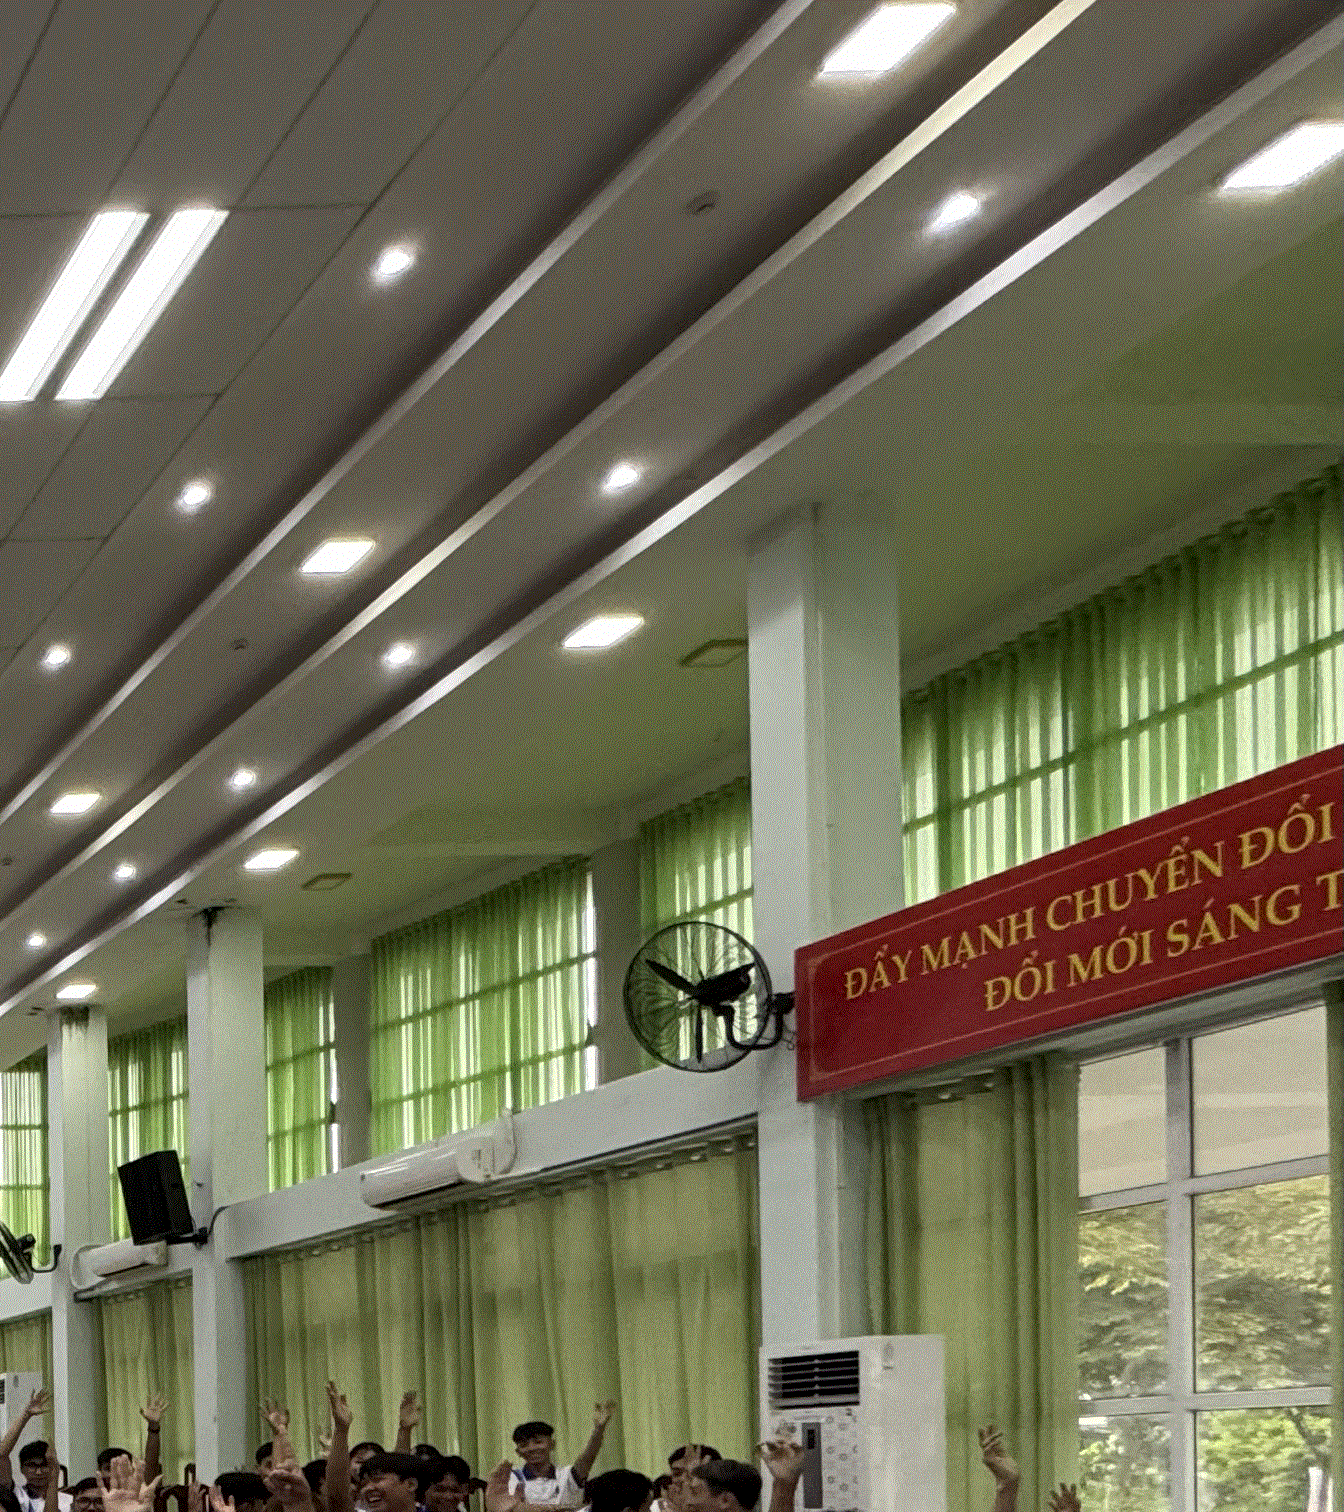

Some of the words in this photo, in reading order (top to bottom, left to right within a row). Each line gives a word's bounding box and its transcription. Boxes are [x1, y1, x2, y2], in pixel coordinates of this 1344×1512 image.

[843, 942, 912, 1001] ĐẨY
[920, 907, 1037, 976] MẠNH
[1045, 836, 1224, 932] CHUYỂN
[1237, 793, 1335, 870] ĐỔI
[983, 950, 1057, 1012] ĐỔI
[1066, 924, 1154, 988] MỚI
[1165, 885, 1302, 960] SÁNG
